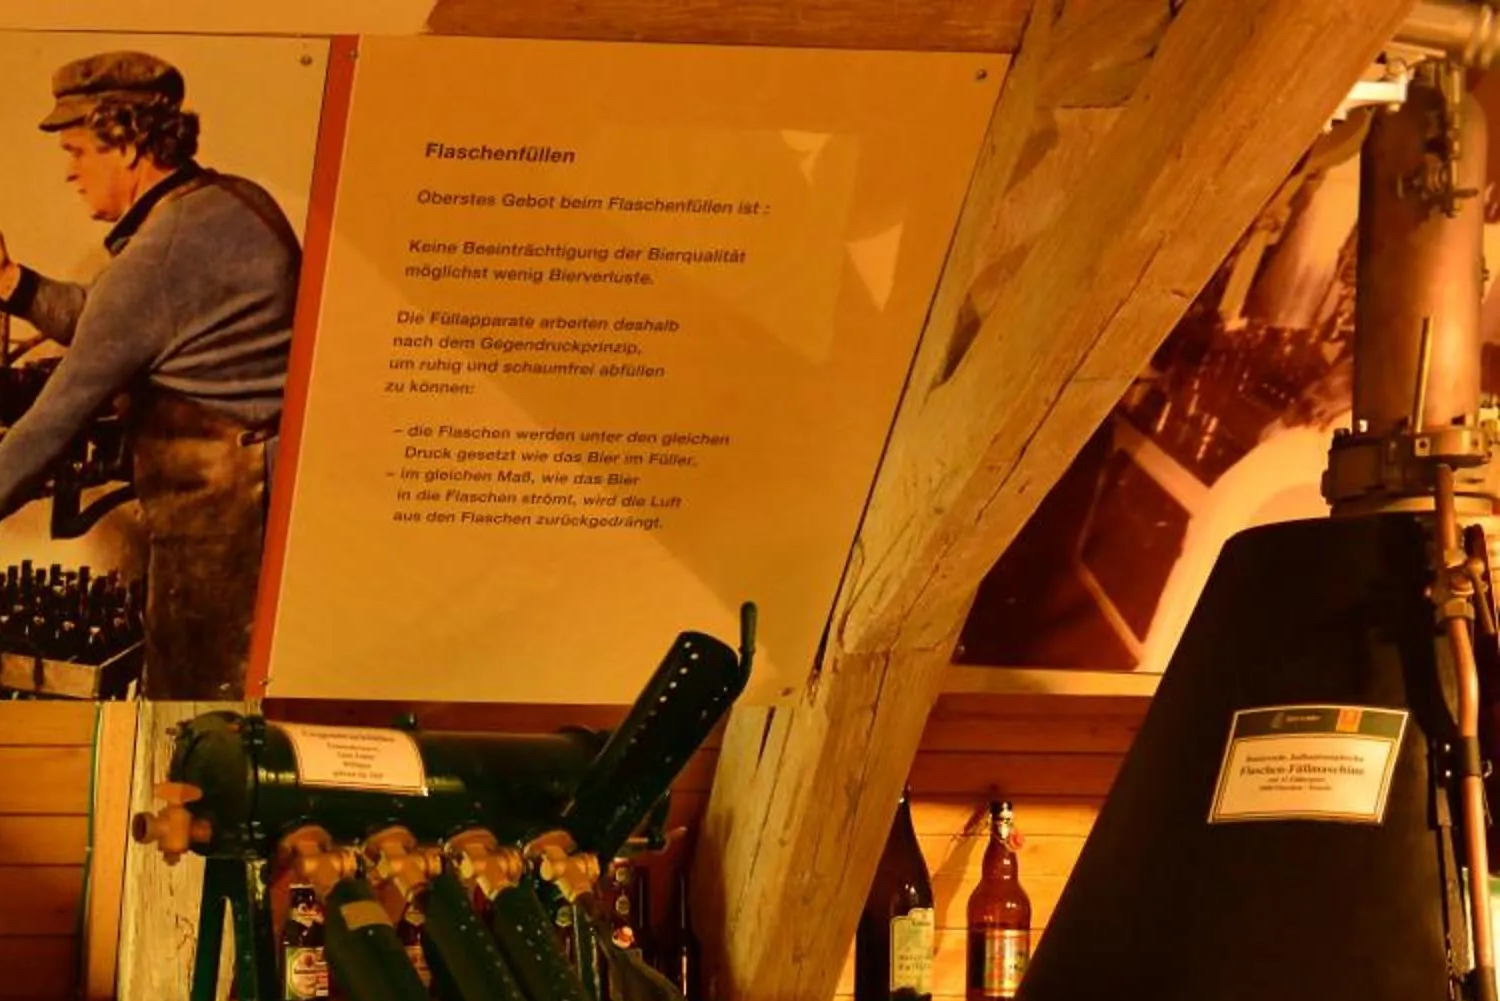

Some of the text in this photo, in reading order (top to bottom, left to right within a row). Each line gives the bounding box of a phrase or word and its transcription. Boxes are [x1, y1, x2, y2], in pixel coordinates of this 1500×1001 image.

[424, 143, 576, 163] Flaschenfüllen
[416, 191, 760, 214] Oberstes Gebot beim Flaschenfüllen ist
[408, 240, 747, 265] Keine Beeinträchtigung der Bierqualität
[403, 265, 654, 284] möglichst wenig Bierverluste.
[395, 312, 681, 332] Die Füllapparate arbeiten deshalb
[391, 336, 643, 357] nach dem Gegendruckprinzip,
[387, 360, 667, 377] um ruhig und schaumfrei abfüllen
[384, 381, 476, 394] zu können:
[406, 425, 732, 448] die Flaschen werden unter den gleichen
[403, 447, 697, 466] Druck gesetzt wie das Bier im Füller.
[399, 469, 640, 486] im gleichen Maß, wie das Bier
[395, 489, 683, 509] in die Flaschen strömt, wird die Luft
[392, 511, 664, 531] aus den Flaschen zurückgedrängt.
